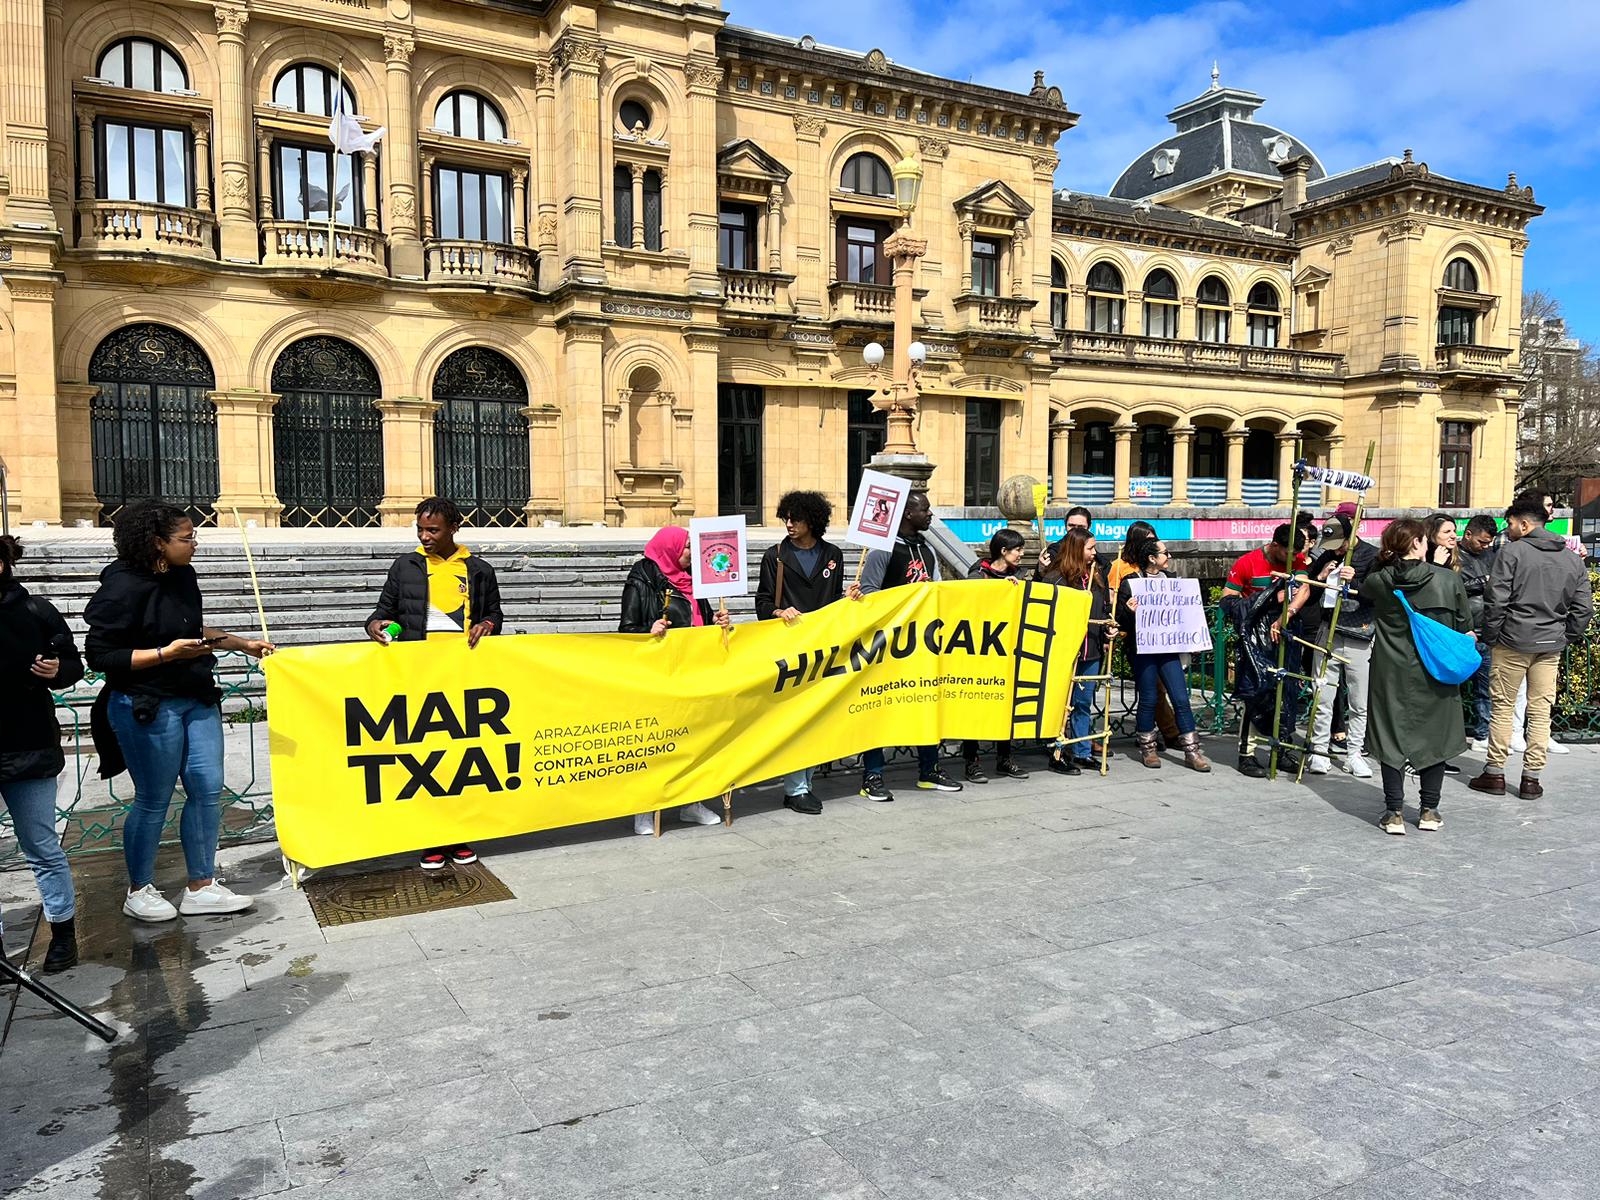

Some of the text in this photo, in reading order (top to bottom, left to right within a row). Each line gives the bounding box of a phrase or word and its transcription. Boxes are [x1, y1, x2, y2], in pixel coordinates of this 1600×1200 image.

[1095, 522, 1129, 539] Nagu
[1231, 521, 1277, 534] Bibliotec
[1145, 580, 1181, 592] NO A LAS
[860, 678, 916, 697] Mugetako
[976, 675, 1006, 686] aurka
[848, 688, 1005, 714] Contra la violenc las fronteras
[345, 687, 511, 746] MAR
[534, 717, 659, 741] ARRAZAKERIA ETA
[534, 726, 690, 757] XENOFOBIAREN AURKA
[534, 742, 676, 772] CONTRA EL RACISMO
[347, 742, 521, 804] TXA!
[535, 761, 648, 787] Y LA XENOFOBIA
